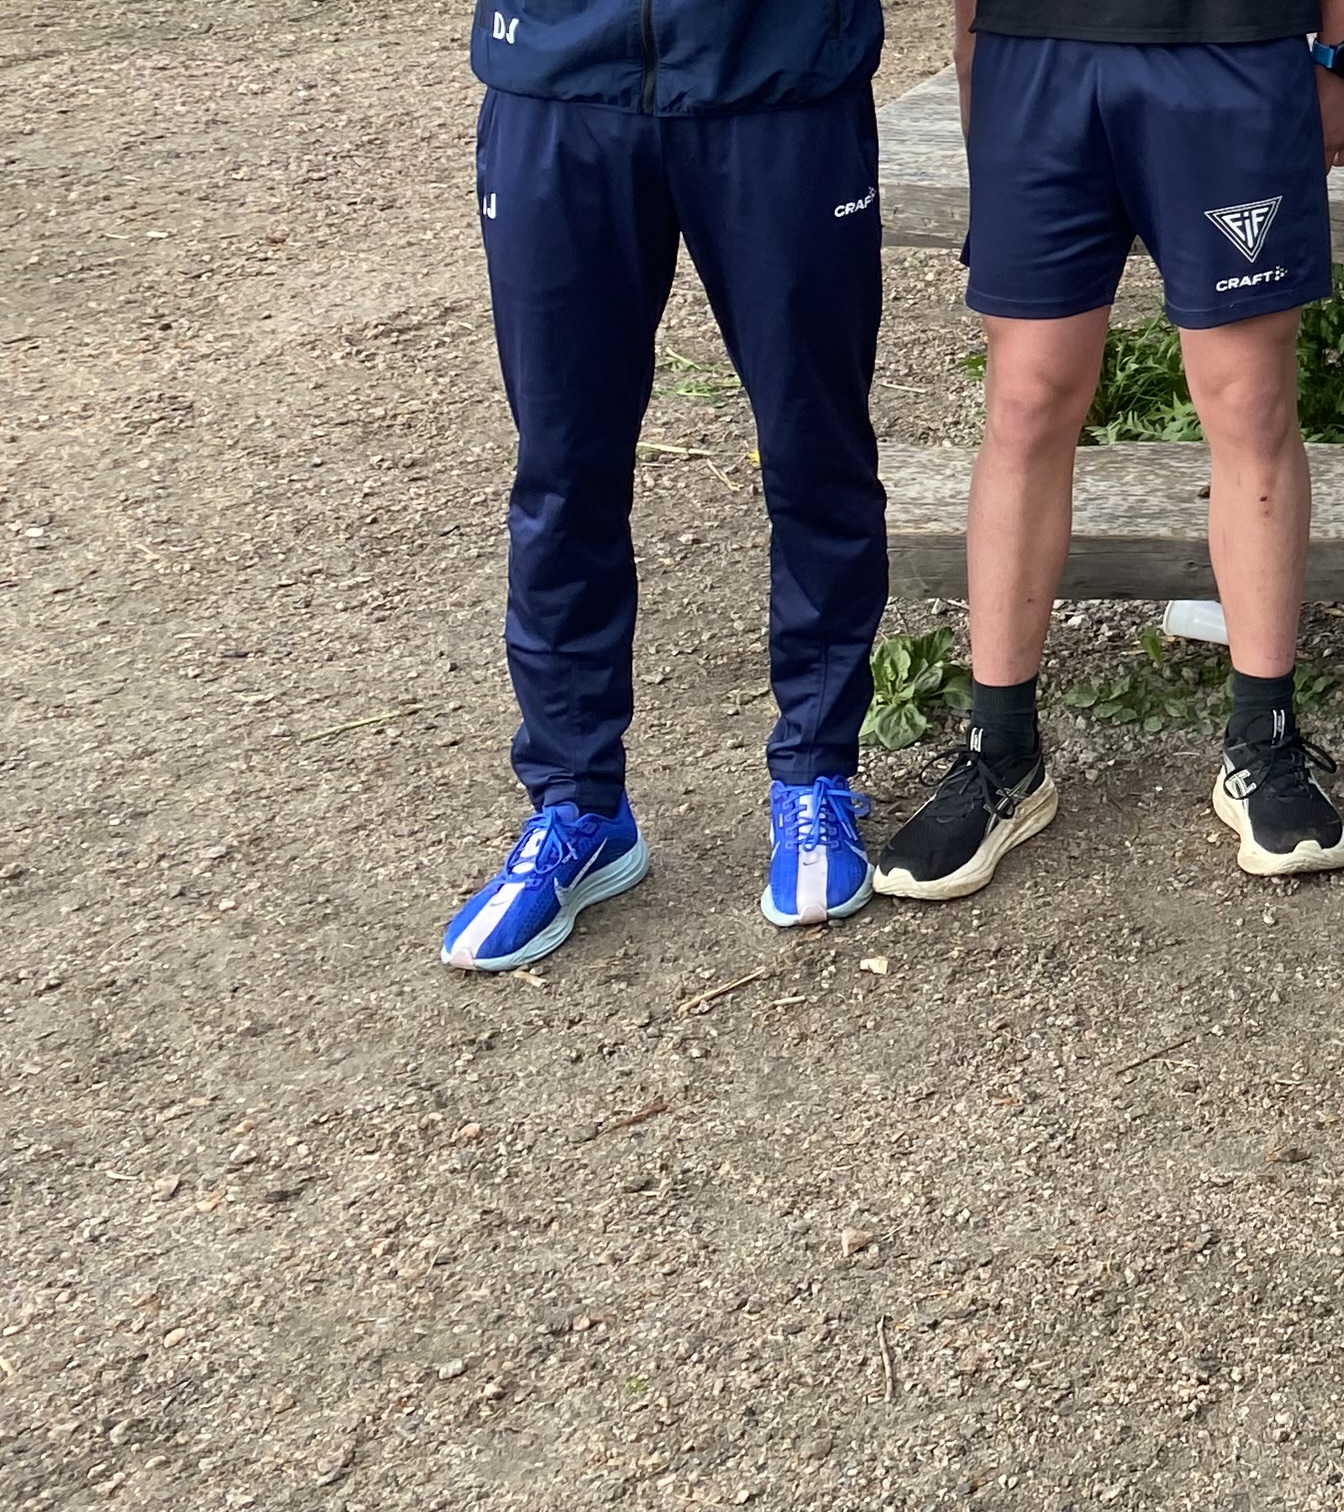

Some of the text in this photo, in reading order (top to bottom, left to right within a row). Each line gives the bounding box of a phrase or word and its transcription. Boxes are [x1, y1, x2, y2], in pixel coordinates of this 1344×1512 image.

[492, 11, 520, 44] DJ
[834, 194, 873, 218] CRAF
[1215, 270, 1274, 292] CRAFT
